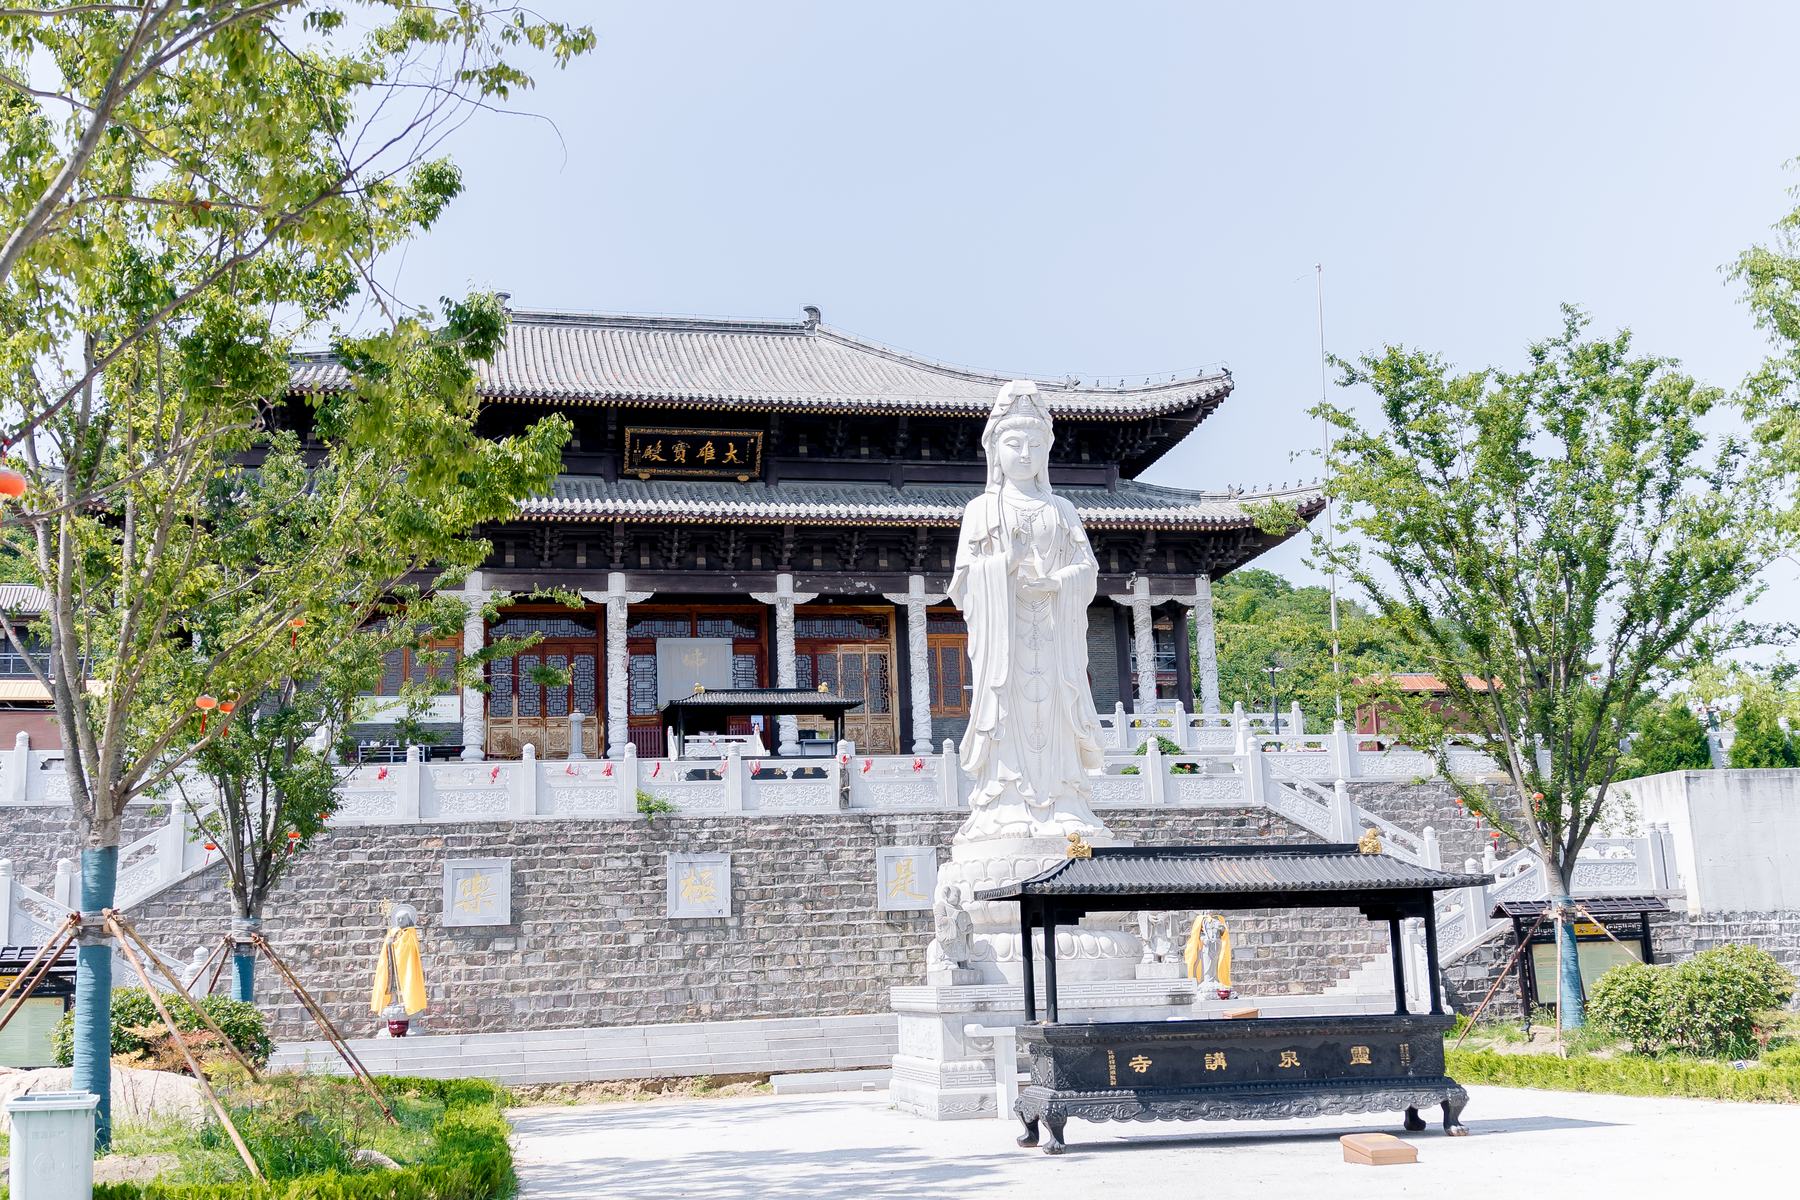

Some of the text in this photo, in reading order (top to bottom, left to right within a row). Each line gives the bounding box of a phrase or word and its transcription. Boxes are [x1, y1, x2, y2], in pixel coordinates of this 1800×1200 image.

[642, 440, 744, 464] 大雄寶殿
[680, 866, 719, 904] 極
[886, 857, 929, 900] 是
[1129, 1045, 1372, 1073] 靈泉講寺
